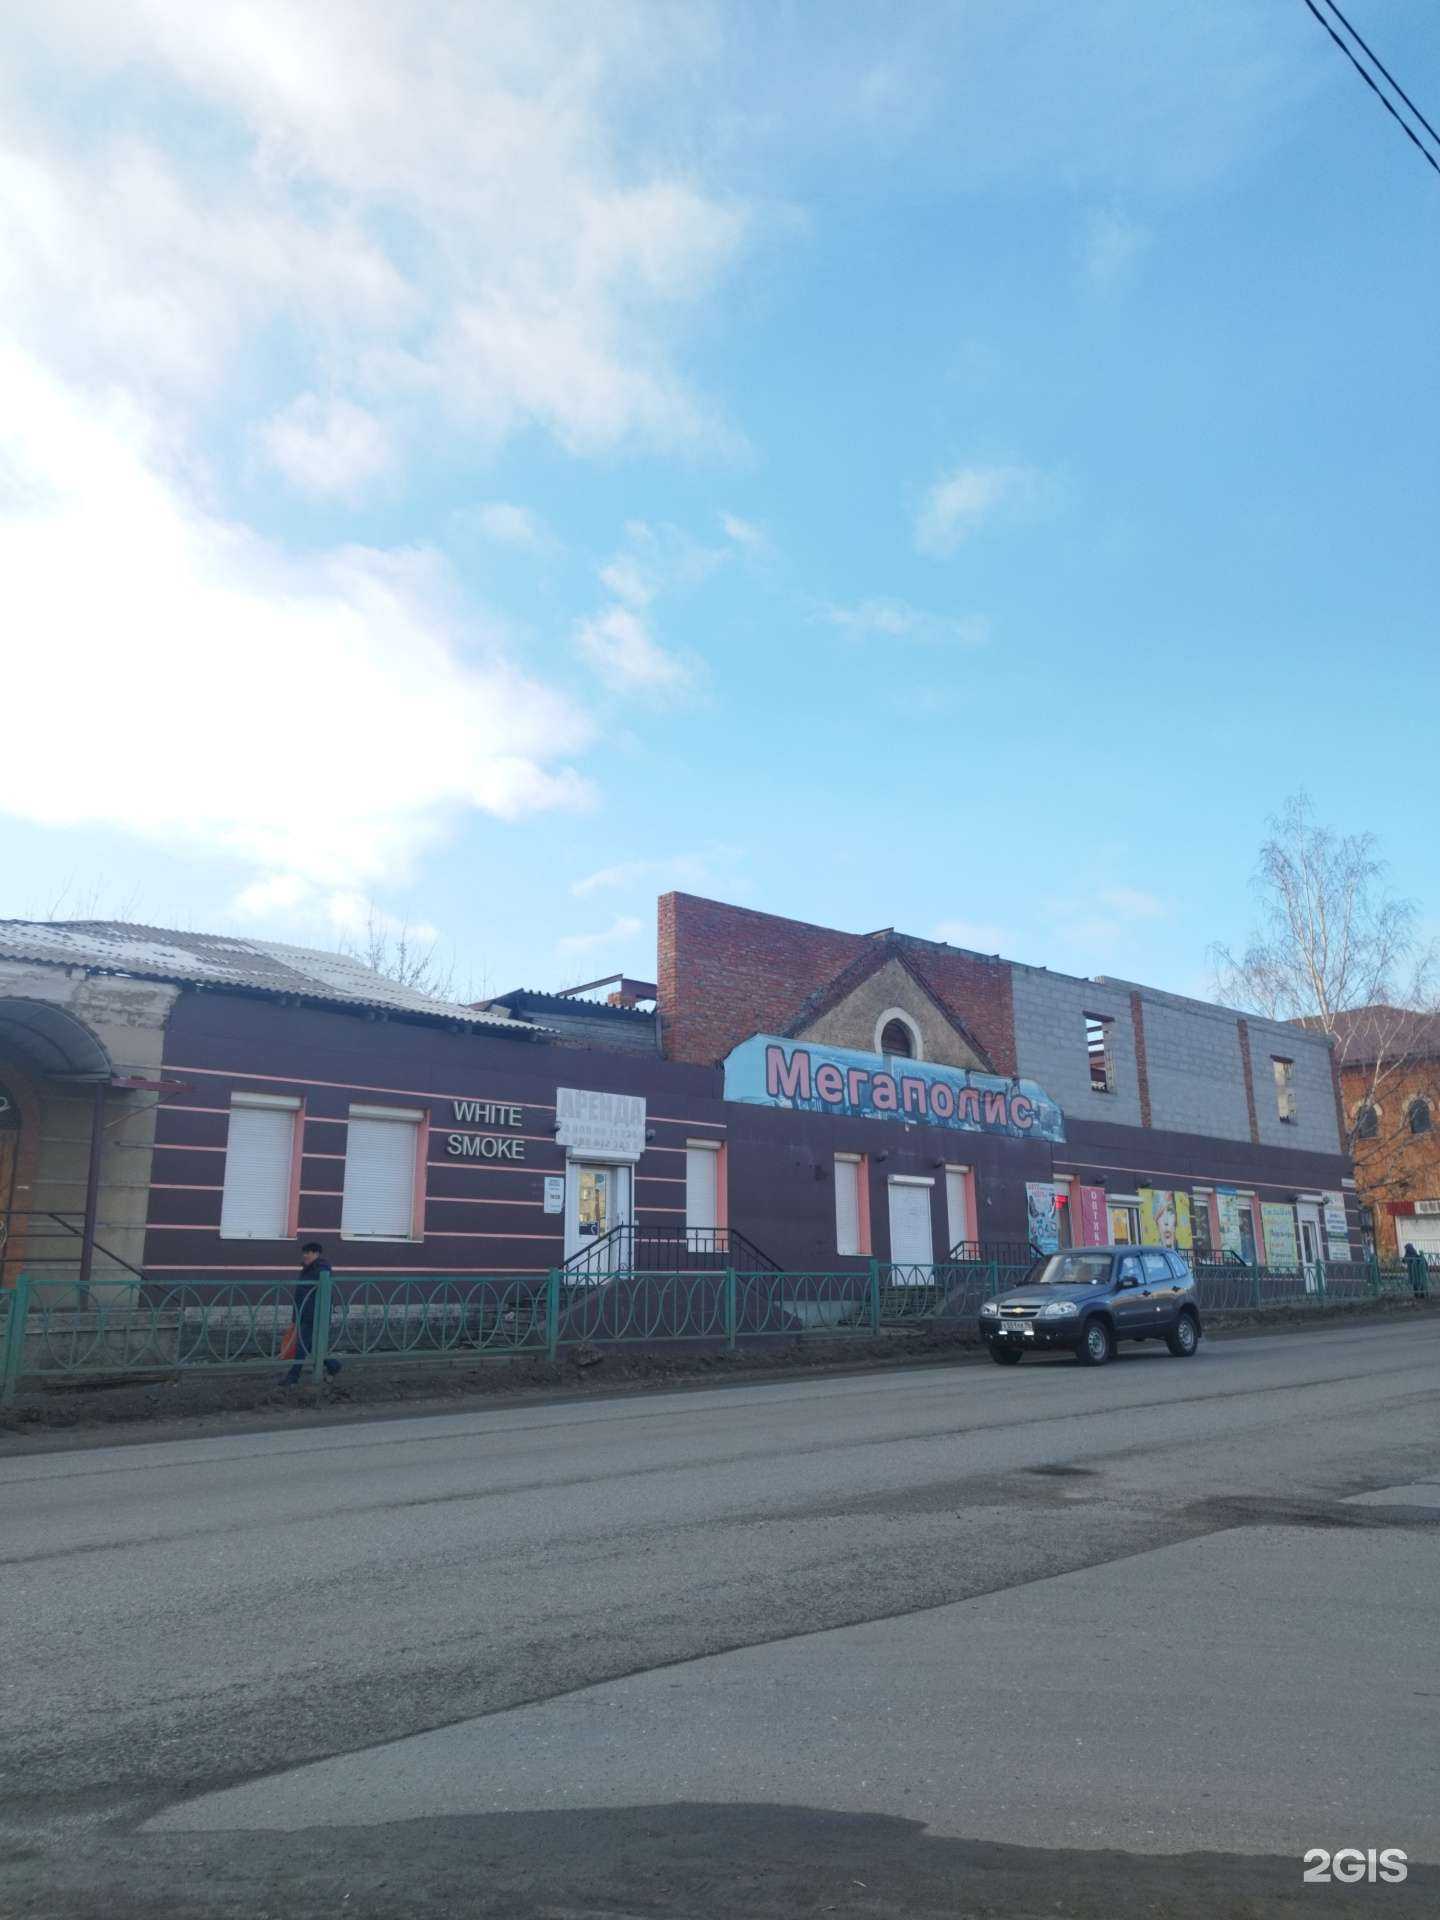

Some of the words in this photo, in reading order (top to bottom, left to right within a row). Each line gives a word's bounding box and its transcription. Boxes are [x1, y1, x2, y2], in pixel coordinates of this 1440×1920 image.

[765, 1045, 1033, 1129] Мегаполис
[454, 1101, 523, 1127] WHITE
[447, 1134, 525, 1160] SMOKE
[1090, 1191, 1101, 1246] ОПТИК
